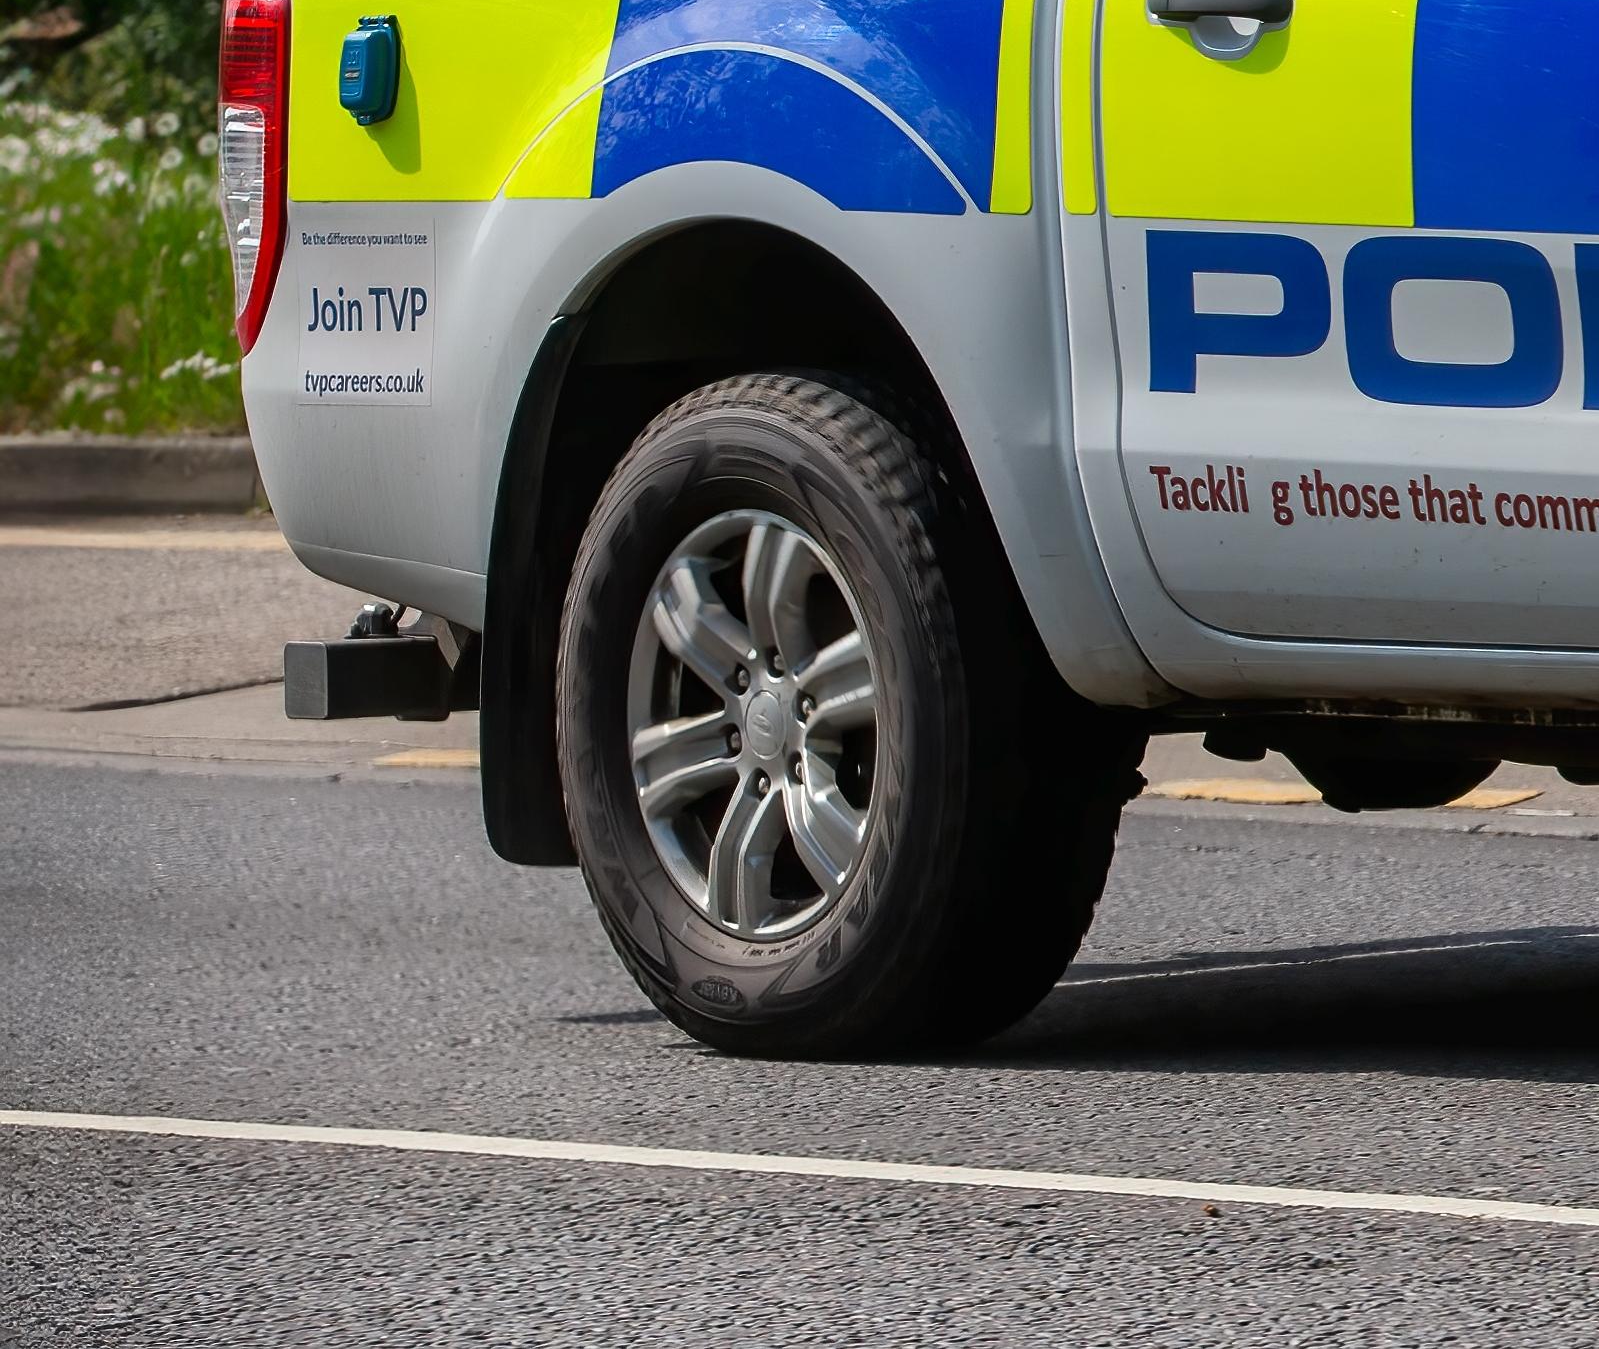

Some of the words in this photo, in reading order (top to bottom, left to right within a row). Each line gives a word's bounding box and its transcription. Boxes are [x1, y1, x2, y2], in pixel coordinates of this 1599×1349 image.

[302, 232, 312, 245] Be
[313, 232, 326, 245] the
[327, 232, 366, 245] difference
[367, 235, 382, 248] you
[383, 233, 403, 245] want
[404, 233, 413, 245] to
[414, 234, 428, 245] see
[307, 286, 363, 332] Join
[368, 287, 428, 332] TVP
[304, 368, 424, 397] tvpcareers.co.uk
[1298, 468, 1401, 520] those
[1407, 473, 1487, 526] that
